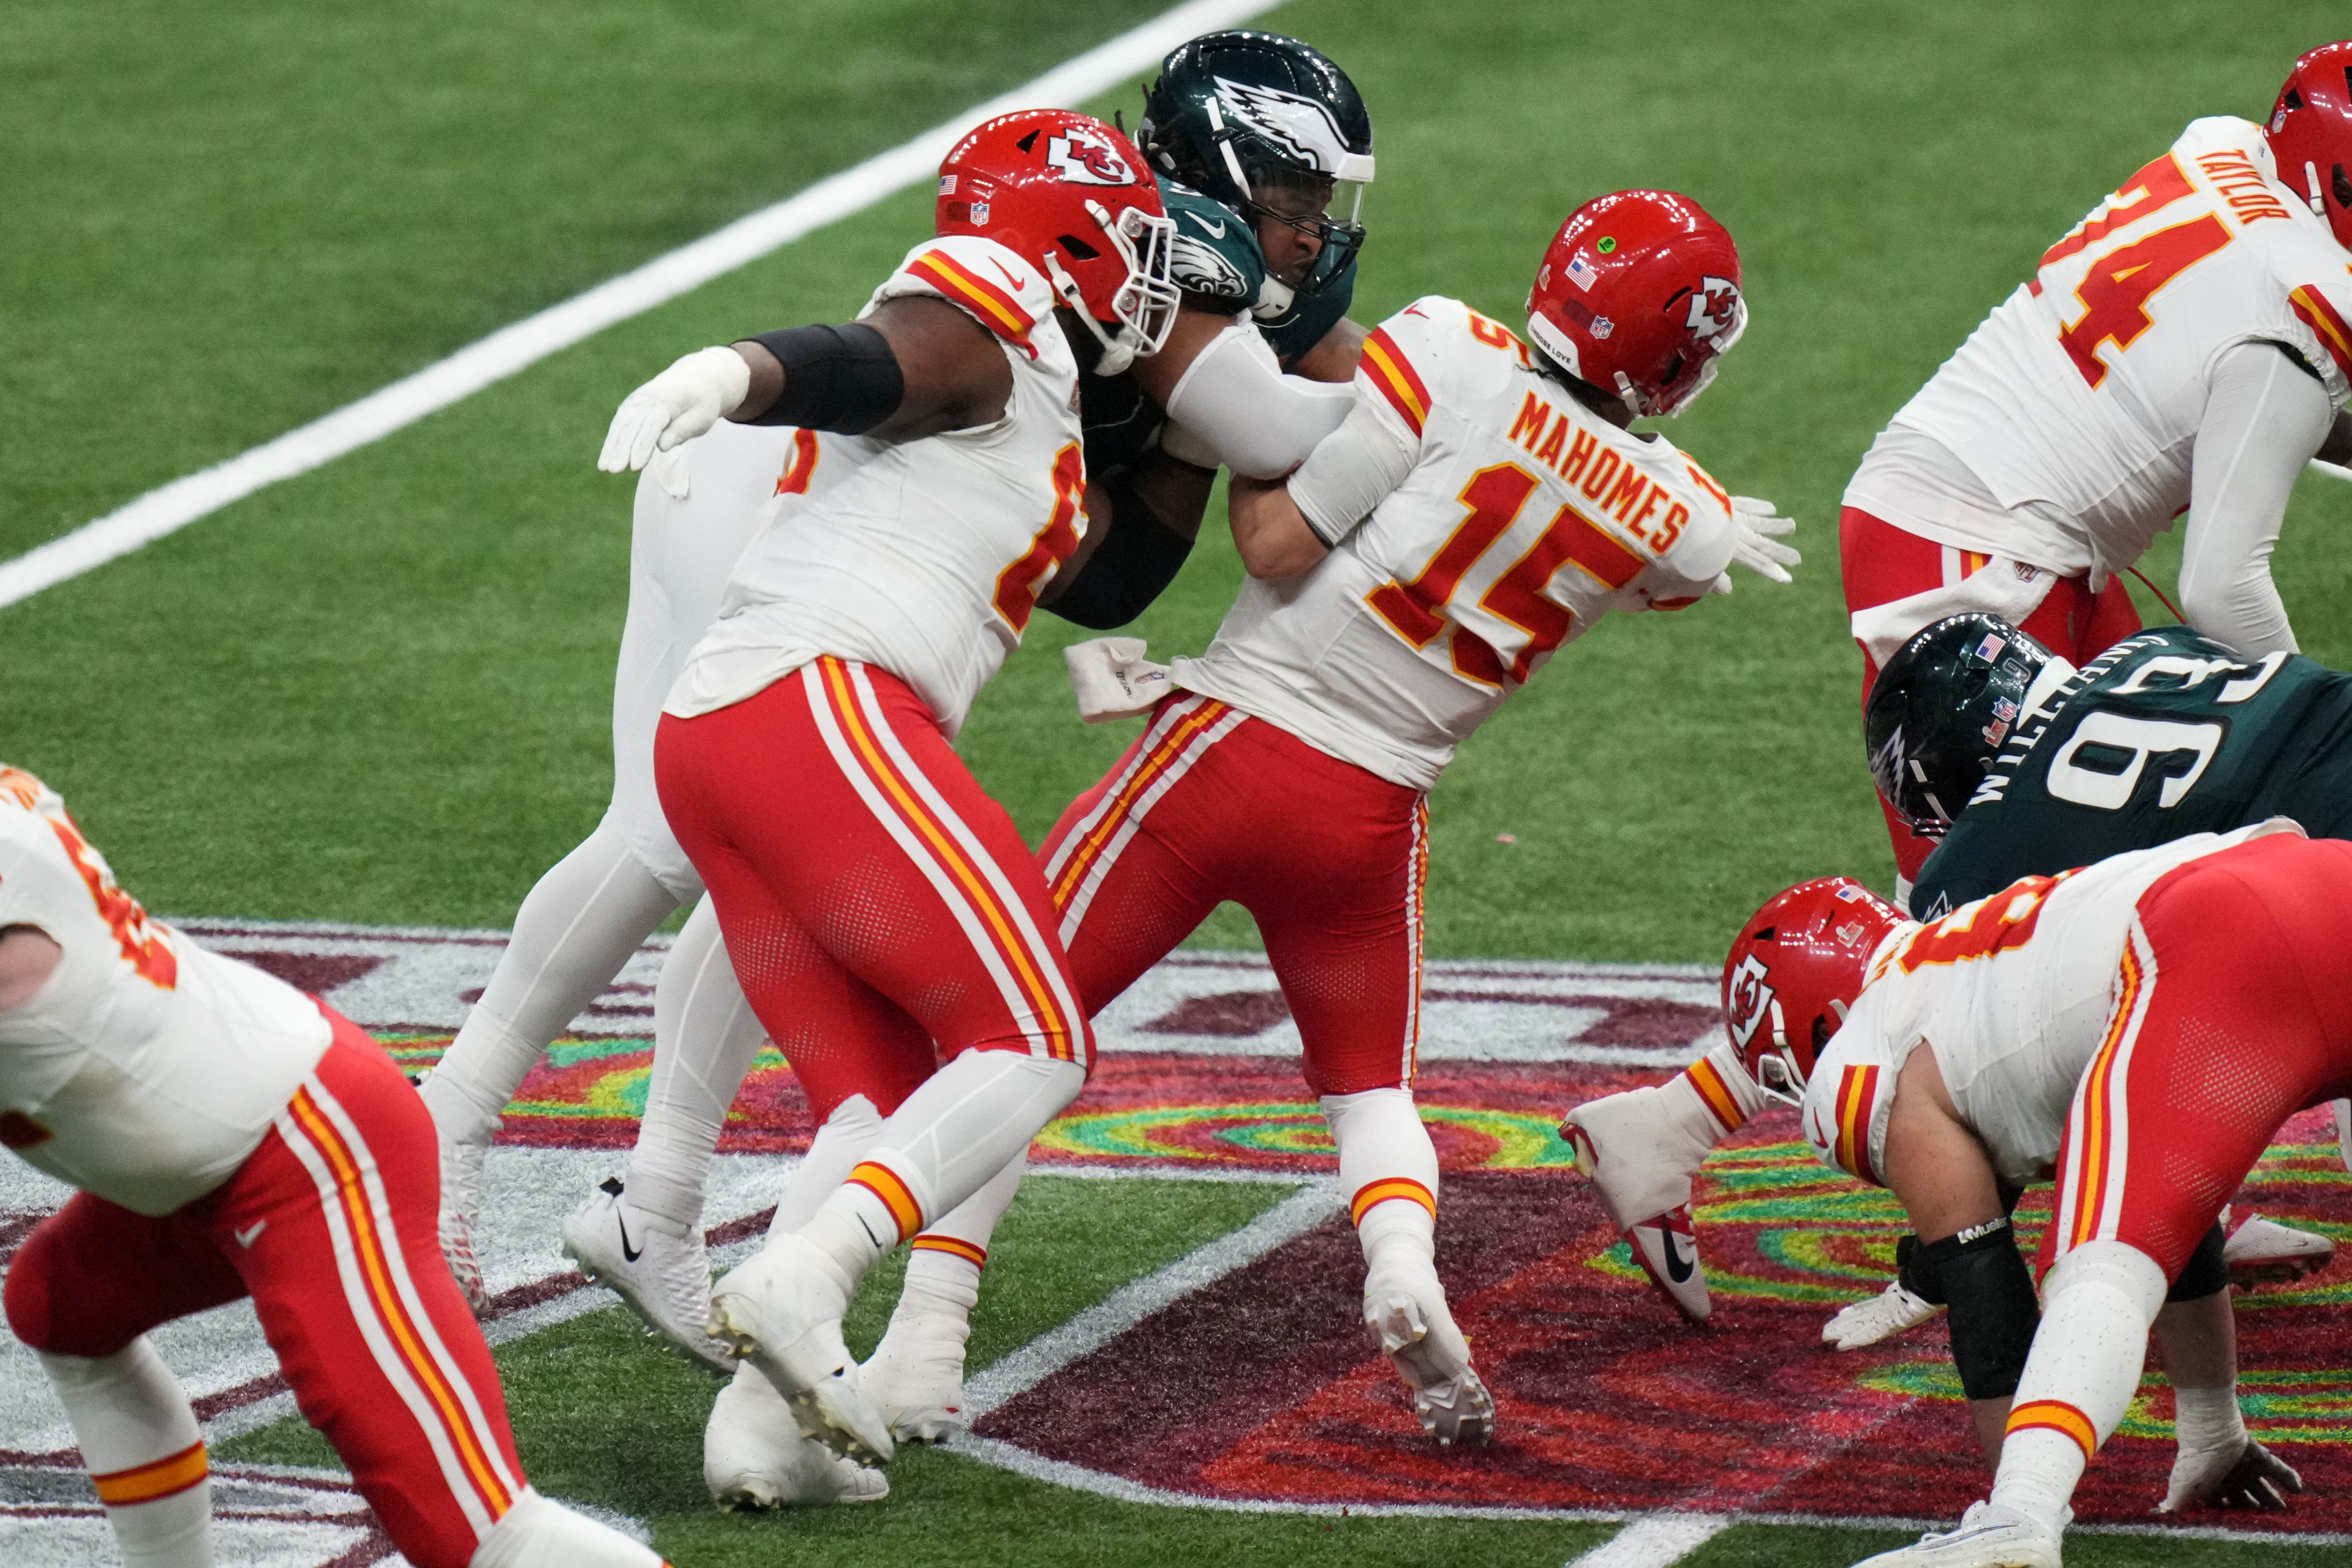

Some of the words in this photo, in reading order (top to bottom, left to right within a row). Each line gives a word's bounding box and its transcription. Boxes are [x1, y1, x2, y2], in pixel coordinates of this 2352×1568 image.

[2194, 148, 2291, 225] TAYLOR
[1466, 304, 1534, 369] 5
[1530, 324, 1551, 350] CHOOSE
[1552, 347, 1572, 364] LOVE
[2027, 151, 2235, 391] 74
[1507, 391, 1689, 556] MAHOMES
[1365, 461, 1647, 690] 15
[2046, 650, 2290, 810] 99
